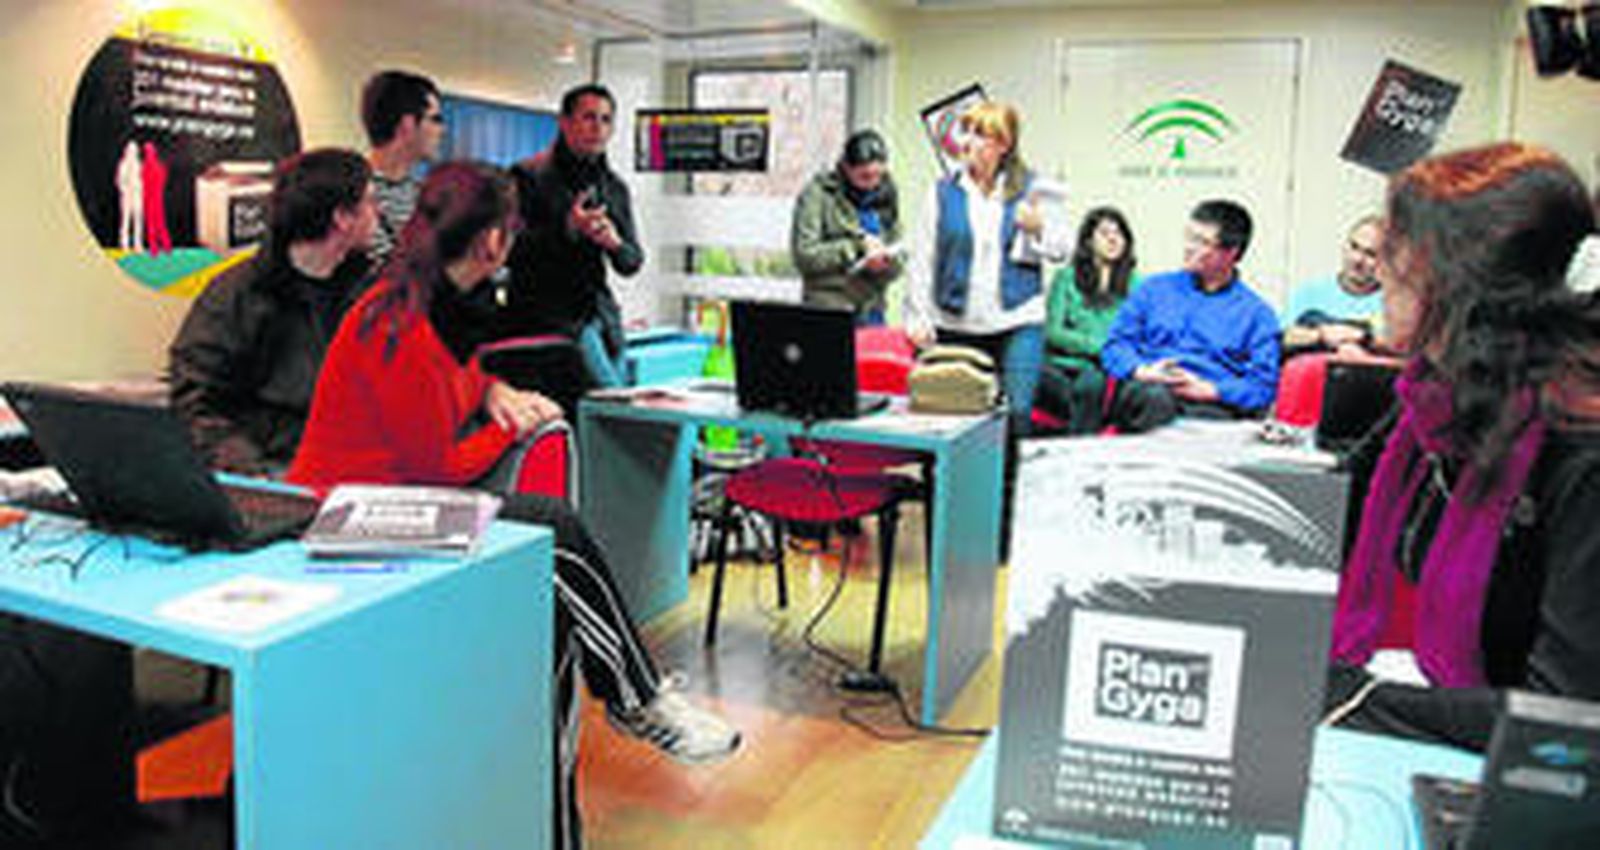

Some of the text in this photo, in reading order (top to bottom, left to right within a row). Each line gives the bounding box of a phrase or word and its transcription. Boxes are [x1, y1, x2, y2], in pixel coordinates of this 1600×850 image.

[1385, 79, 1434, 115] Plan
[1374, 99, 1434, 135] Gyga
[1104, 648, 1188, 690] Plan
[1100, 680, 1201, 723] Gyga
